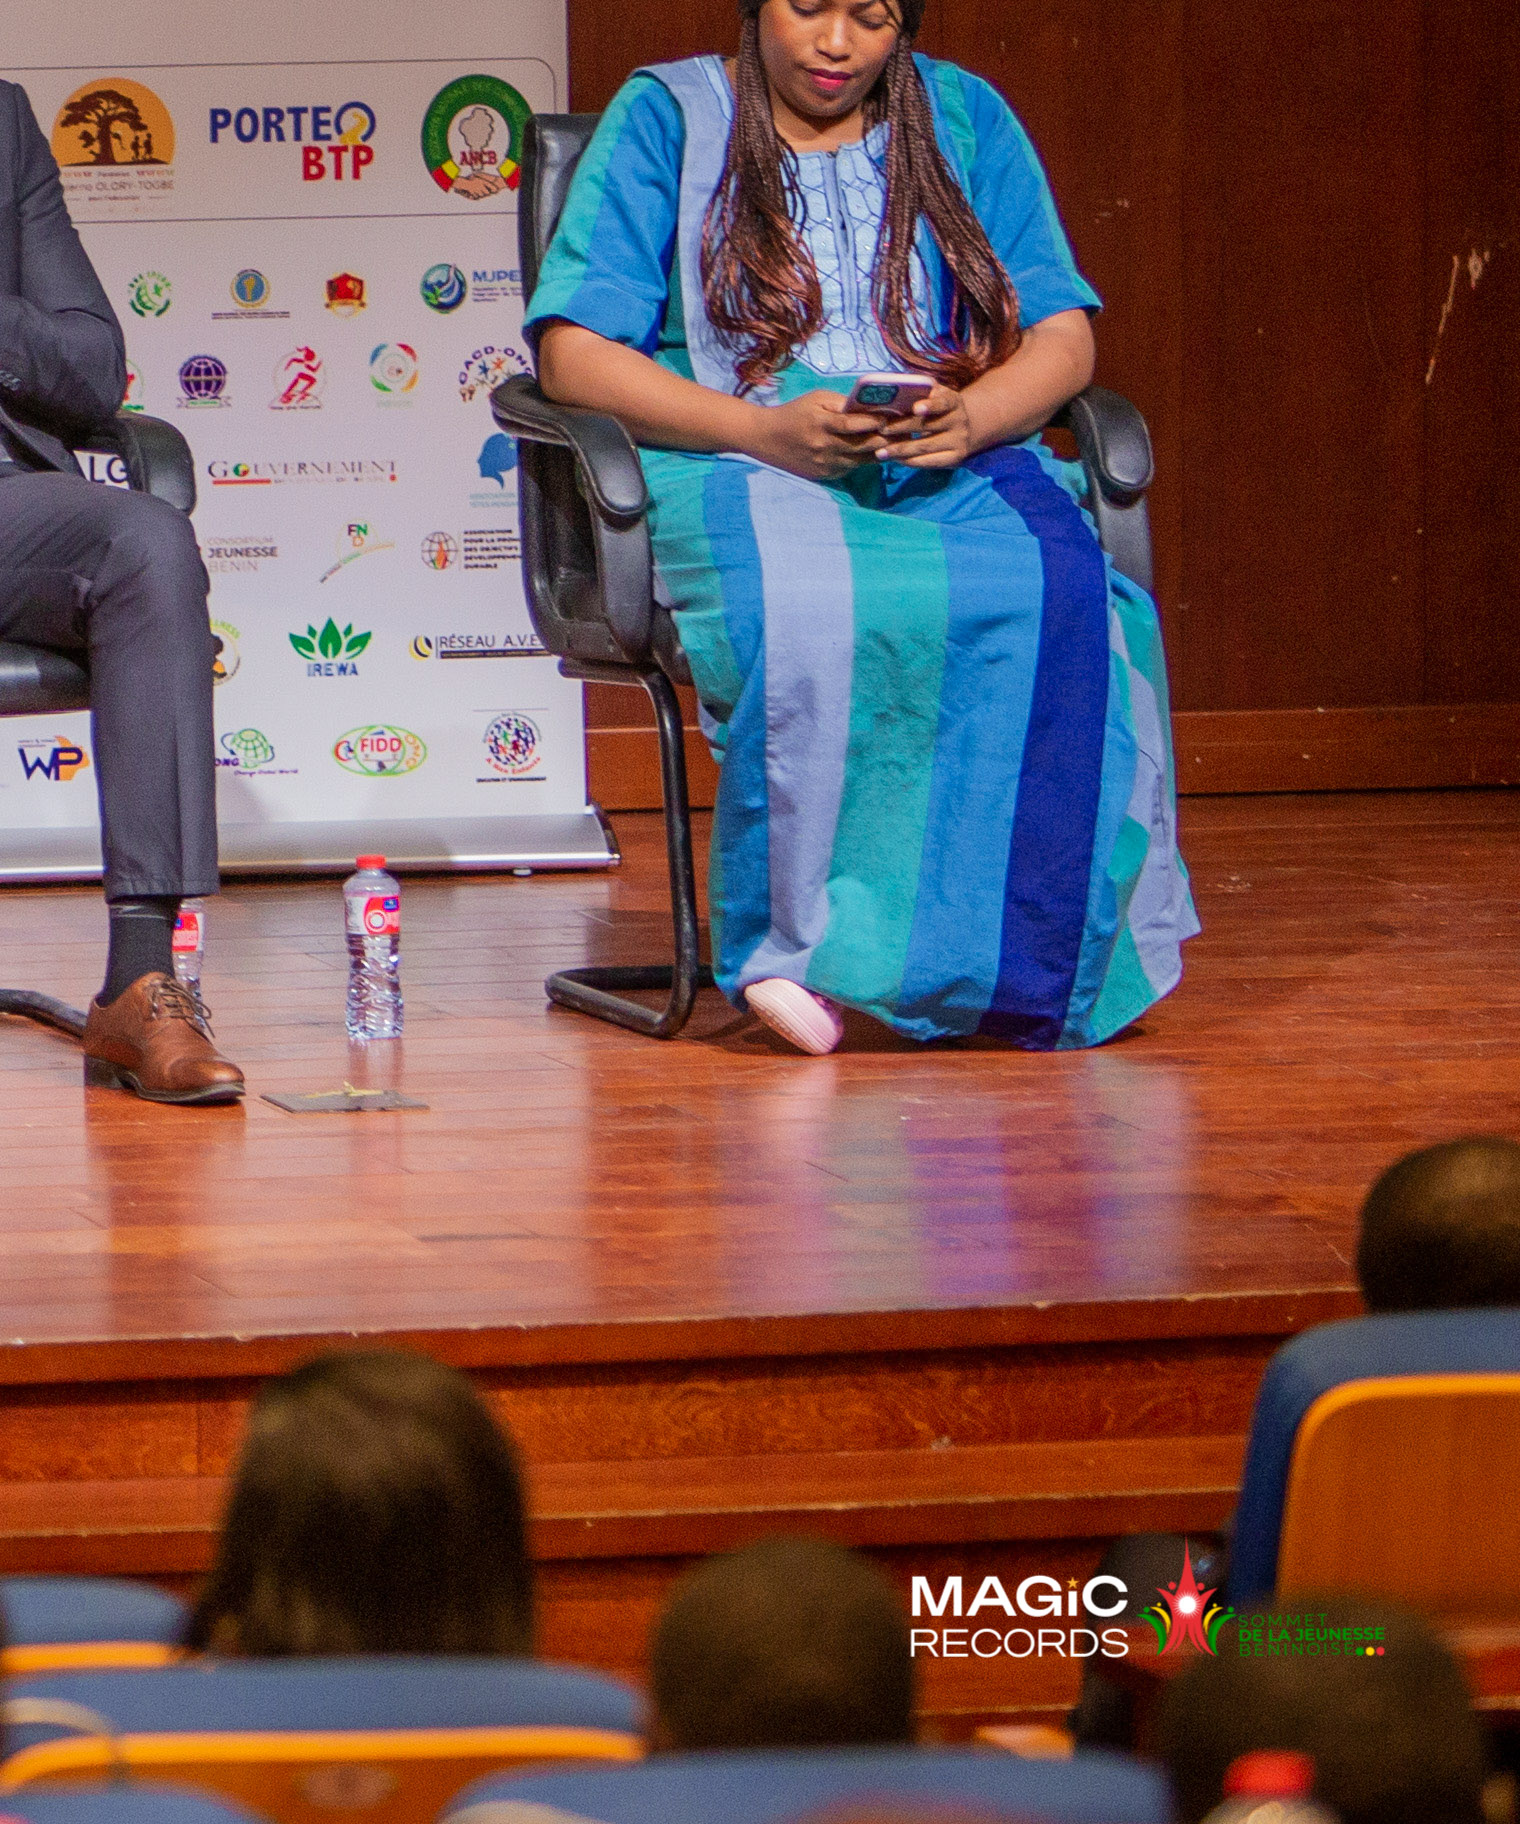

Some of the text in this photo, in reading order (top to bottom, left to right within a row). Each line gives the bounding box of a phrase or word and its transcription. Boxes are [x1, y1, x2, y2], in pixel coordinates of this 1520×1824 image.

[302, 145, 375, 181] BTP
[472, 269, 521, 283] MJPE
[89, 455, 128, 484] LG
[208, 546, 278, 558] JEUNESSE
[439, 634, 496, 650] RÉSEAU
[307, 662, 359, 677] IREWA
[360, 737, 402, 753] FIDD
